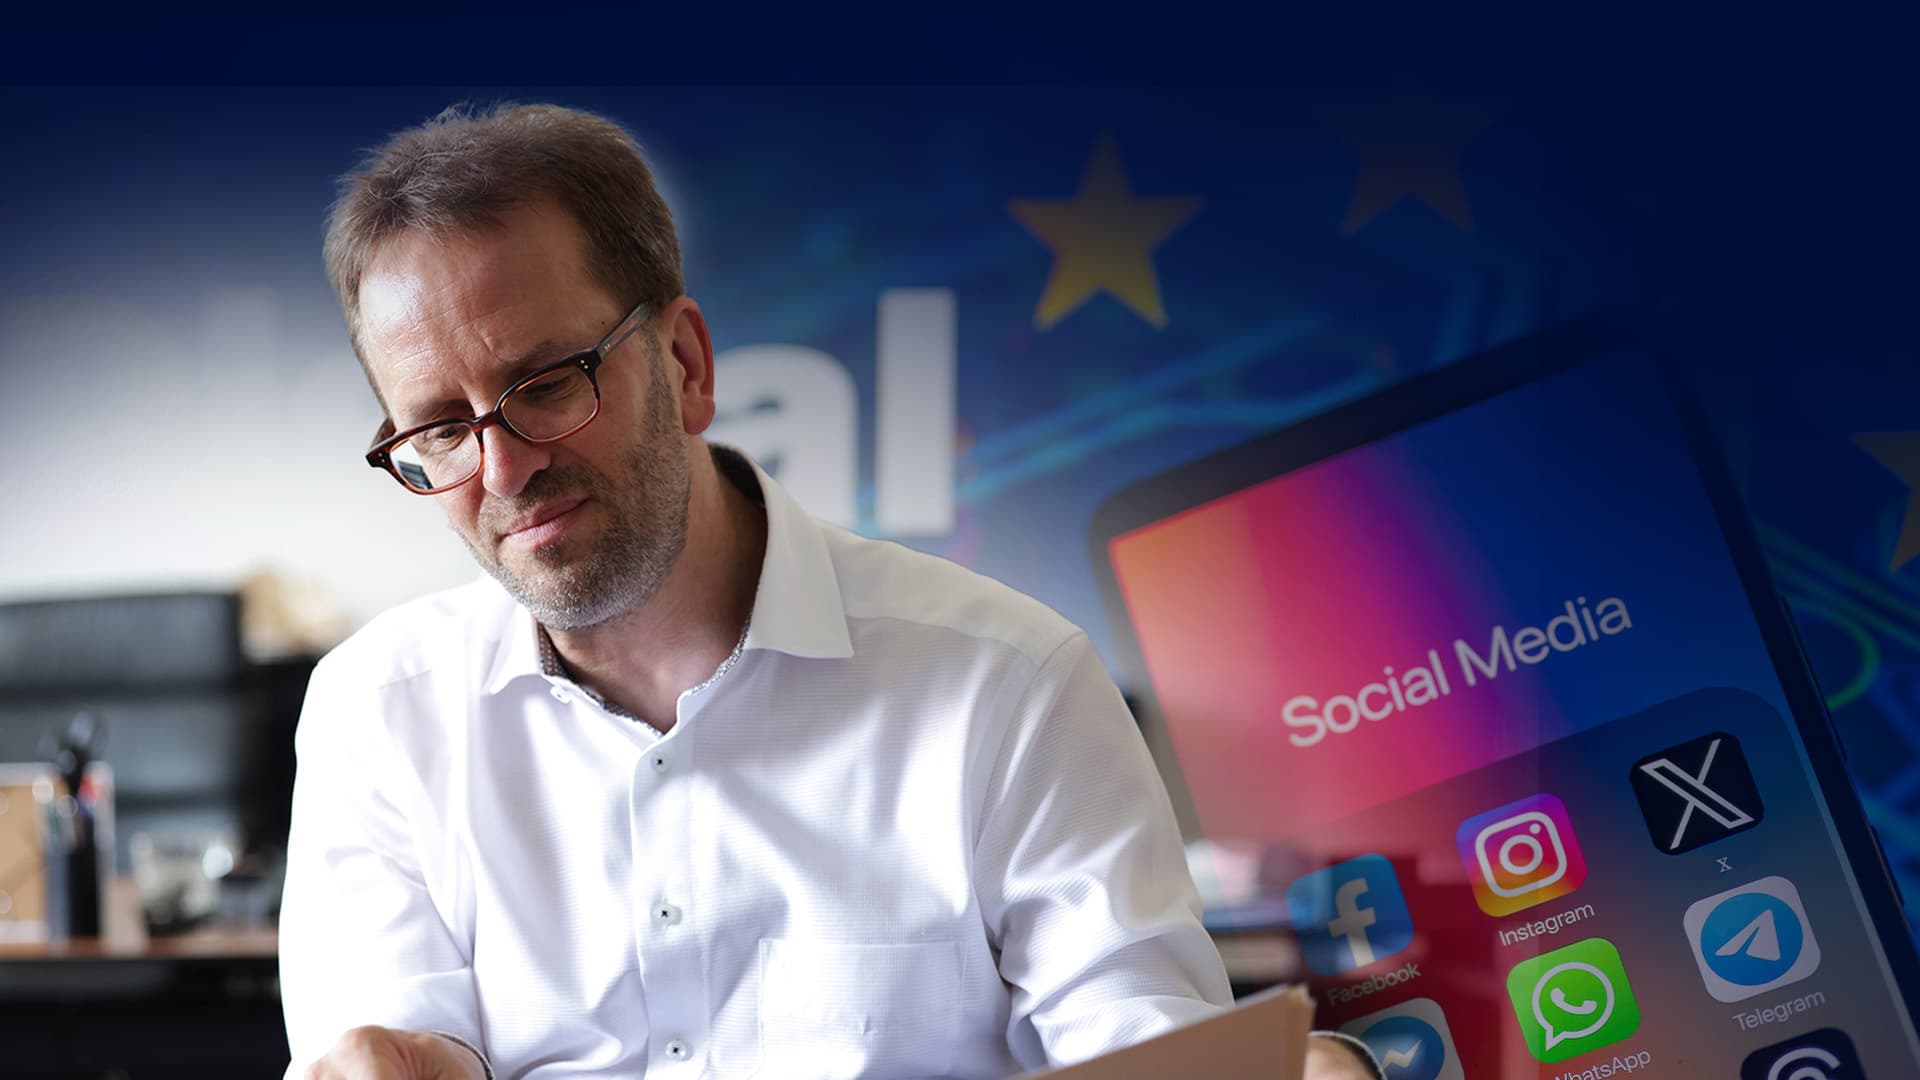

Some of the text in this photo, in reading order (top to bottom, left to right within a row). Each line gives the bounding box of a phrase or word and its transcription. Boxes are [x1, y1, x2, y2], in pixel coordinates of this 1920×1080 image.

[1281, 596, 1633, 748] Social Media
[1328, 877, 1376, 968] f
[1499, 904, 1595, 947] Instagram
[1327, 962, 1422, 1007] Facebook
[1732, 991, 1826, 1032] Telegram
